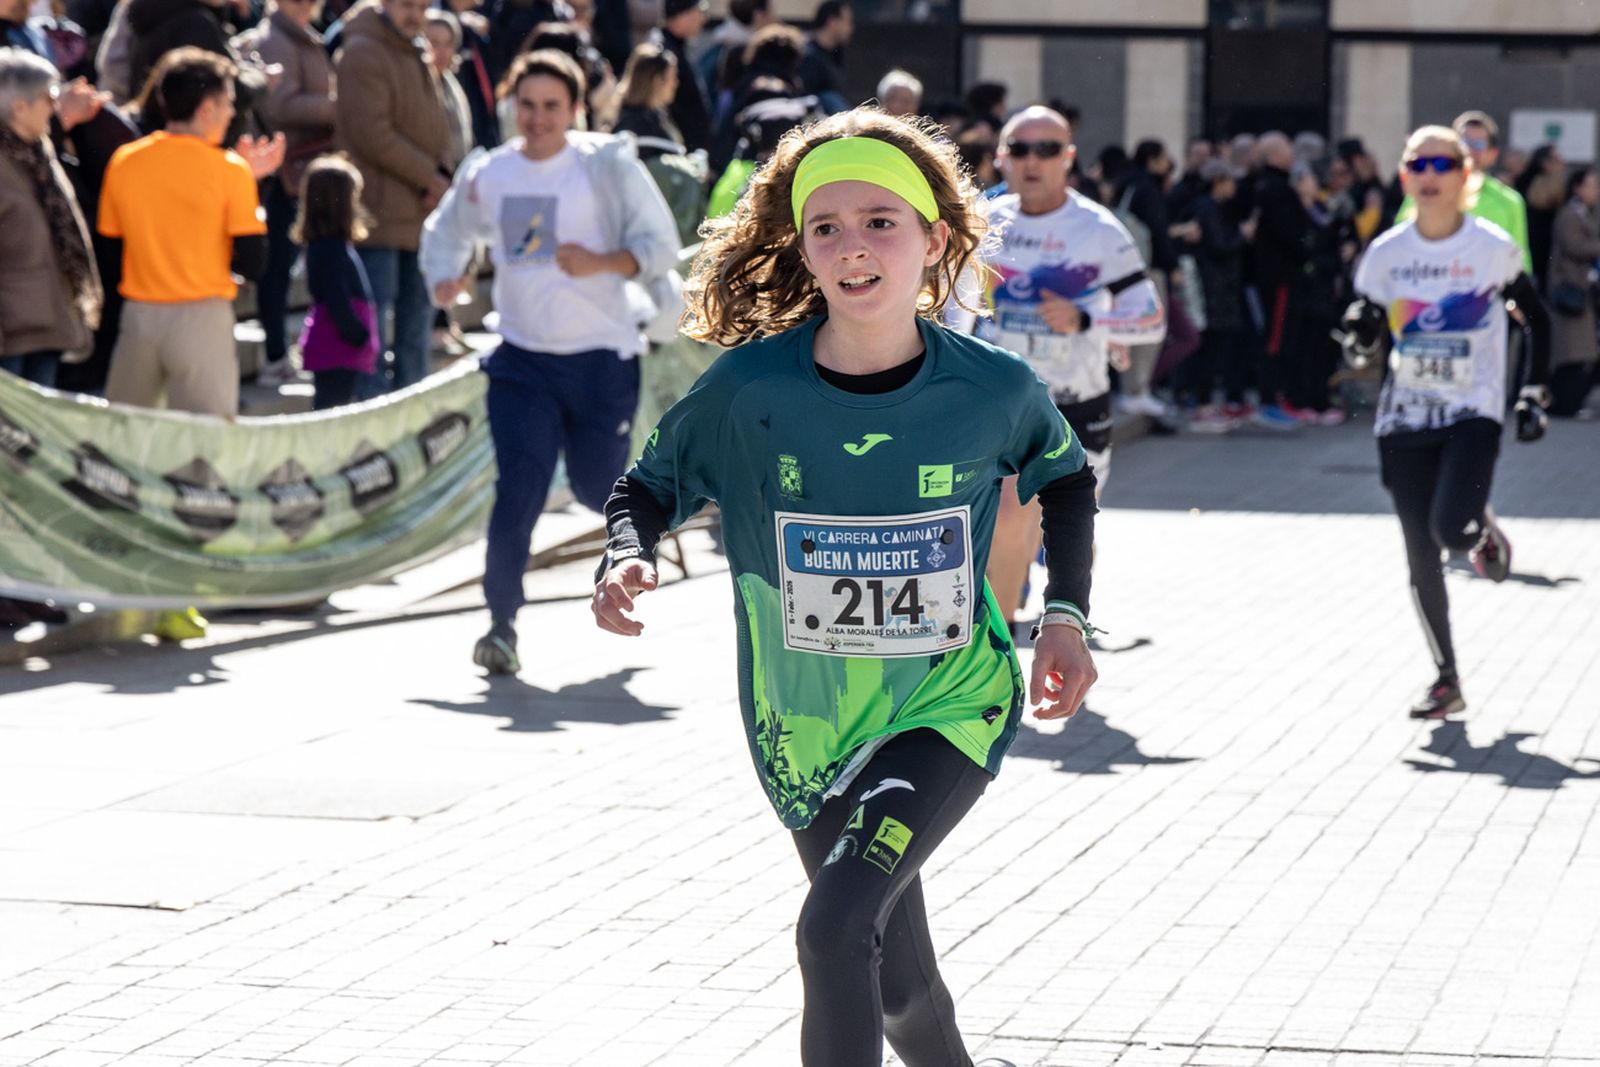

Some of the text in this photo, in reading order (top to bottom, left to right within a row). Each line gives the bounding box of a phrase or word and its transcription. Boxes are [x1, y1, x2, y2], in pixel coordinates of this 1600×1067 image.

[803, 530, 815, 543] VI
[818, 531, 879, 545] CARRERA
[804, 549, 920, 571] BUENA MUERTE
[832, 578, 924, 626] 214
[826, 627, 933, 637] ALBA MORALES DE LA TORRE
